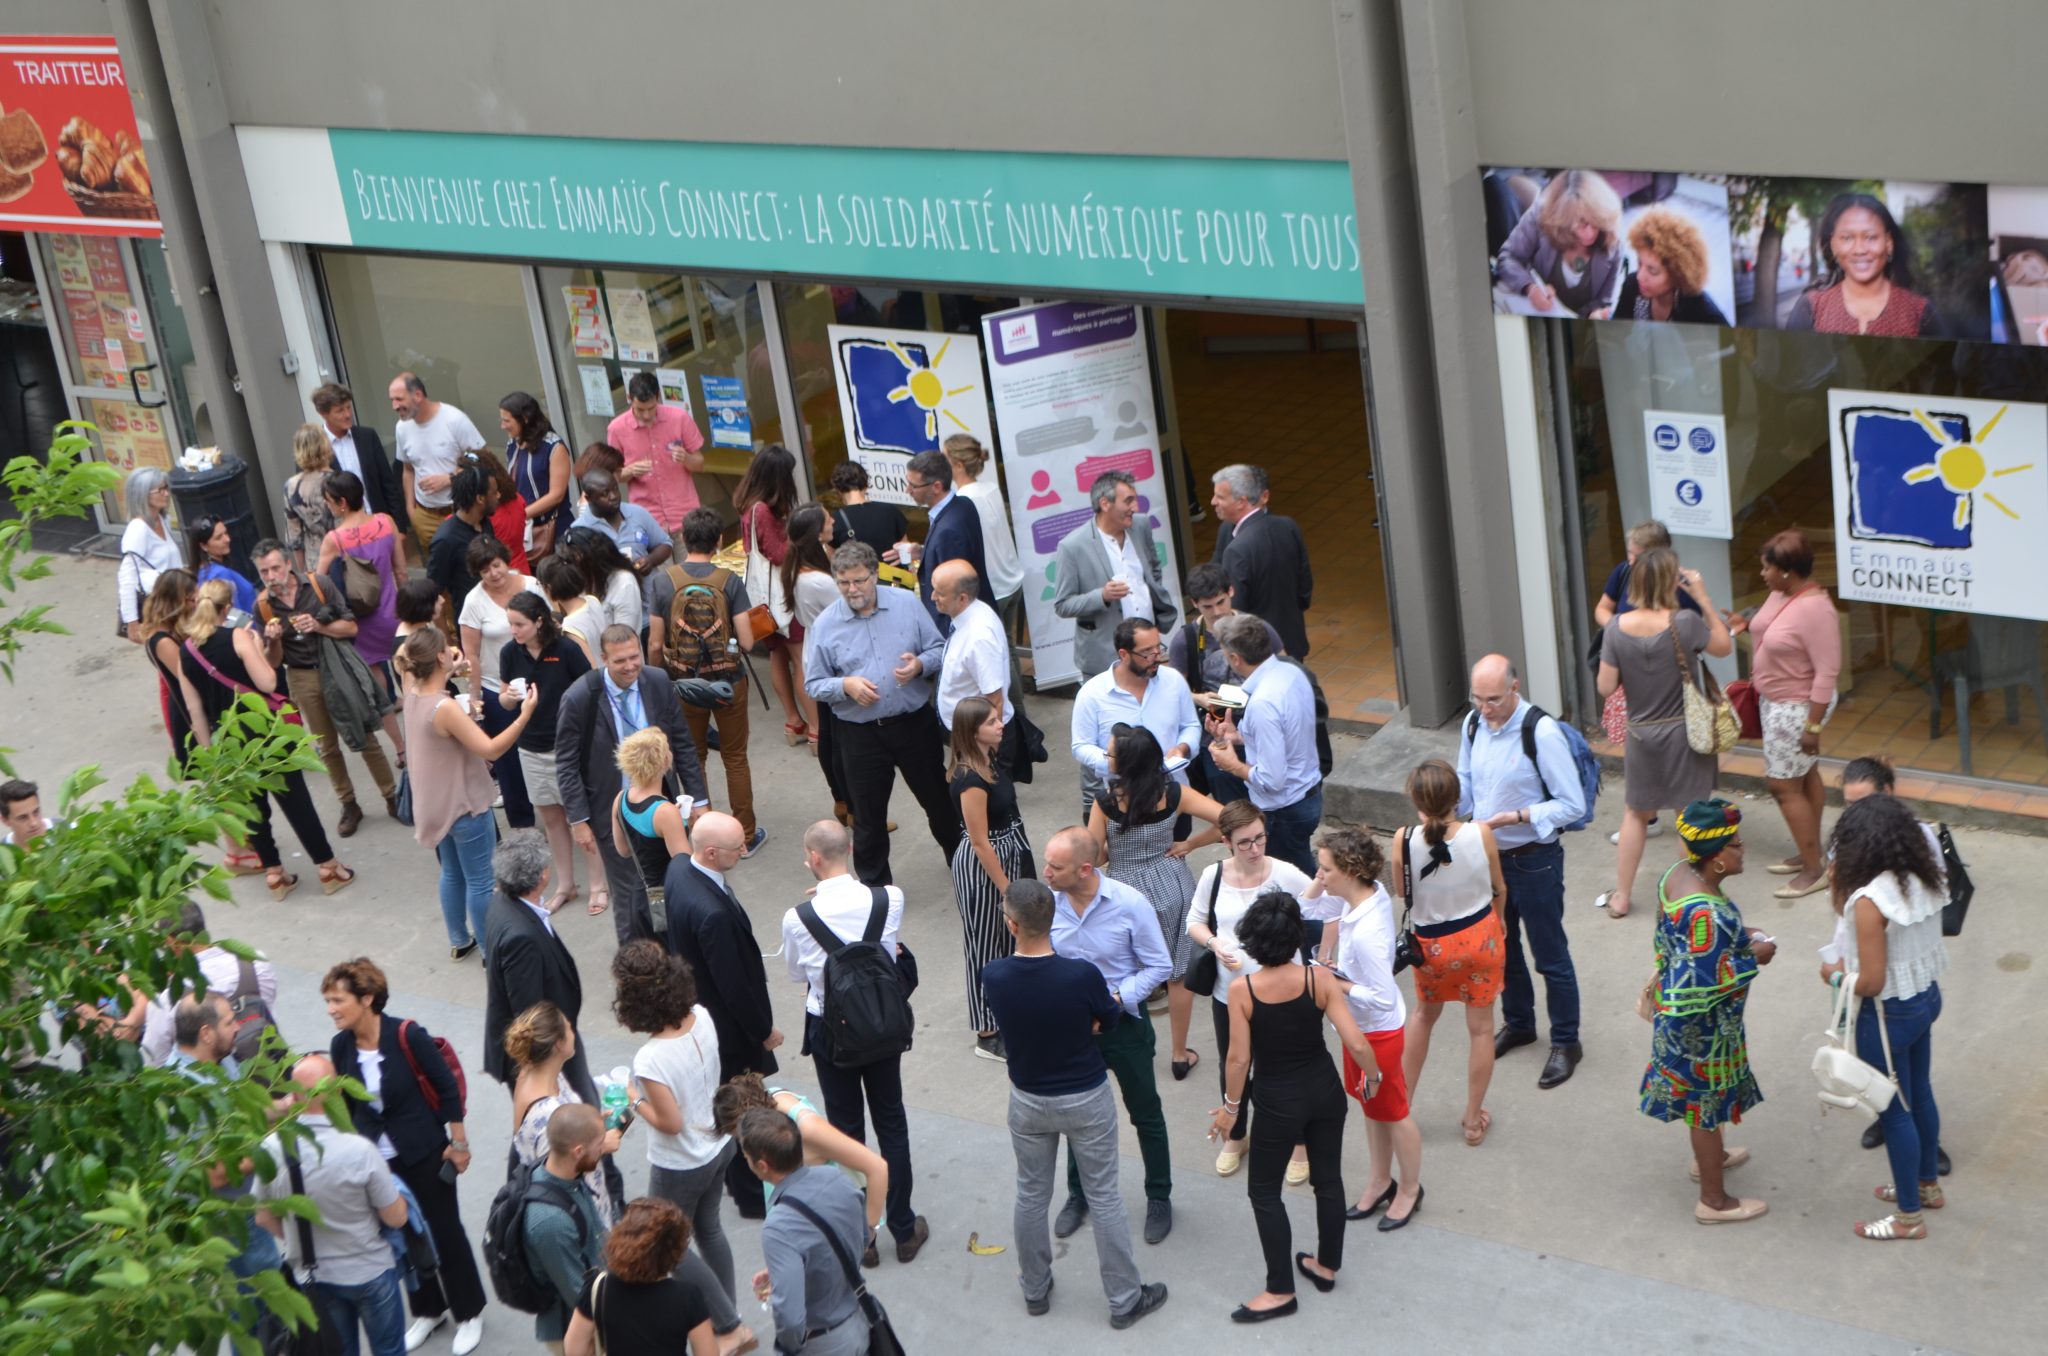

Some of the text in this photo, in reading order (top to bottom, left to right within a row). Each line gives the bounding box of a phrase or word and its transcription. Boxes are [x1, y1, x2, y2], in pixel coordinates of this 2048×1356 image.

[13, 60, 125, 86] TRAITTEUR
[353, 168, 491, 228] BIENVENUE
[494, 180, 547, 230] CHEZ
[549, 176, 656, 237] EMMAÜS
[799, 193, 833, 245] LA
[837, 188, 1000, 254] SOLIDARITÉ
[1005, 191, 1190, 277] NUMÉRIQUE
[1196, 209, 1275, 268] POUR
[1280, 212, 1361, 272] TOUS
[859, 455, 906, 475] Emm
[866, 474, 910, 493] CONN
[1849, 545, 1972, 577] Emmaüs
[1851, 567, 1973, 598] CONNECT
